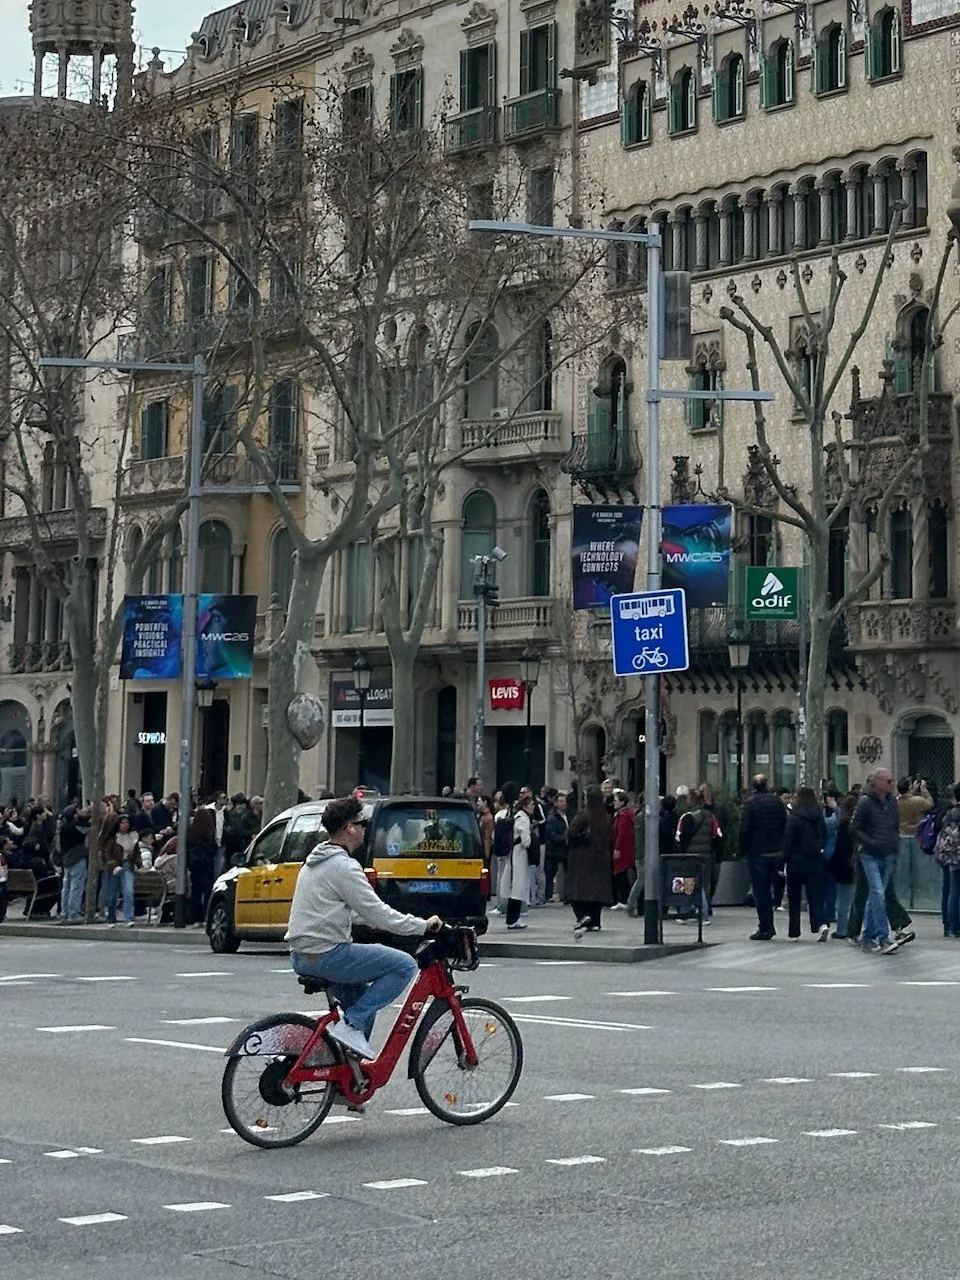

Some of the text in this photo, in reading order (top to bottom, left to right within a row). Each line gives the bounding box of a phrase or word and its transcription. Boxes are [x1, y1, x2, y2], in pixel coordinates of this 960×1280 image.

[589, 541, 615, 552] WHERE
[580, 551, 625, 563] TECHNOLOGY
[666, 552, 723, 563] MWC26
[582, 562, 619, 573] CONNECTS
[752, 594, 792, 607] adif
[135, 623, 168, 632] POWERFUL
[634, 623, 663, 641] taxi
[138, 631, 164, 640] VISIONS
[201, 632, 249, 641] MWC26
[134, 640, 168, 648] PRACTICAL
[135, 648, 165, 657] INSIGHTS
[138, 731, 166, 744] SEPHOR
